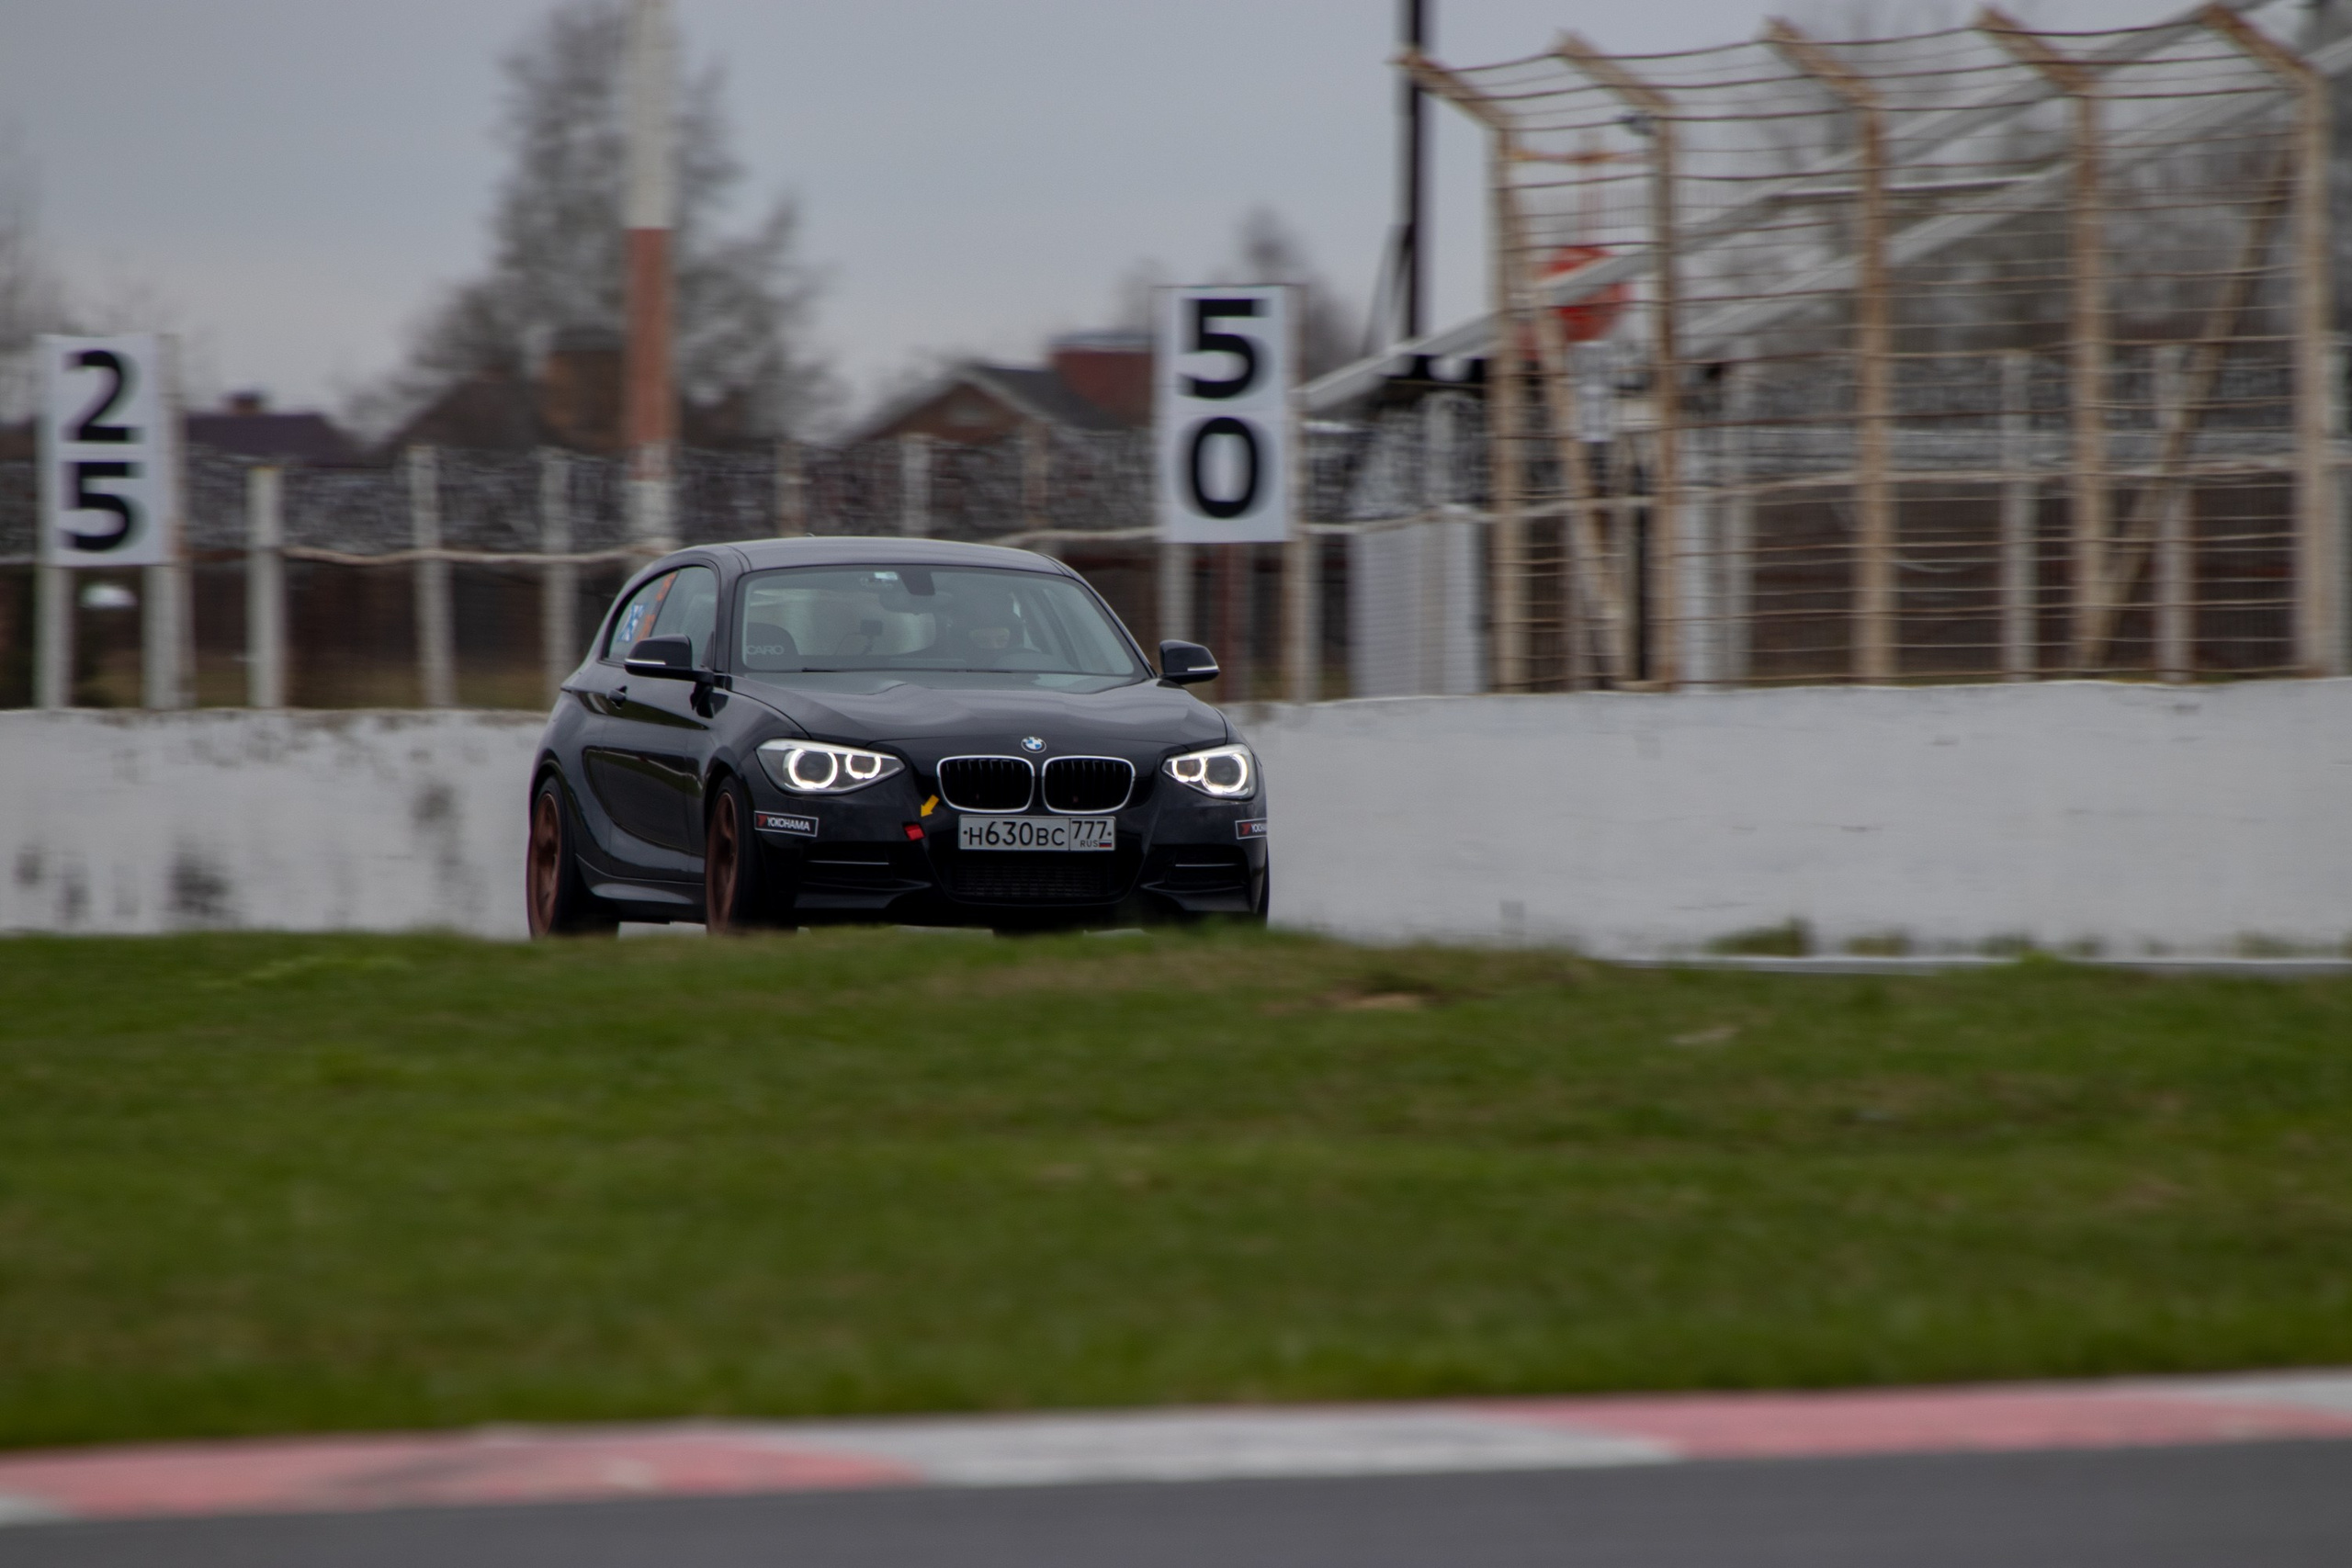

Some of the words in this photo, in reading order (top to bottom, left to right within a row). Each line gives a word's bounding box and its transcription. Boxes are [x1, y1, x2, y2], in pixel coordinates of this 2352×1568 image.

[766, 817, 810, 831] YOKOHAMA
[1071, 820, 1107, 840] 777
[1080, 840, 1099, 848] RUS
